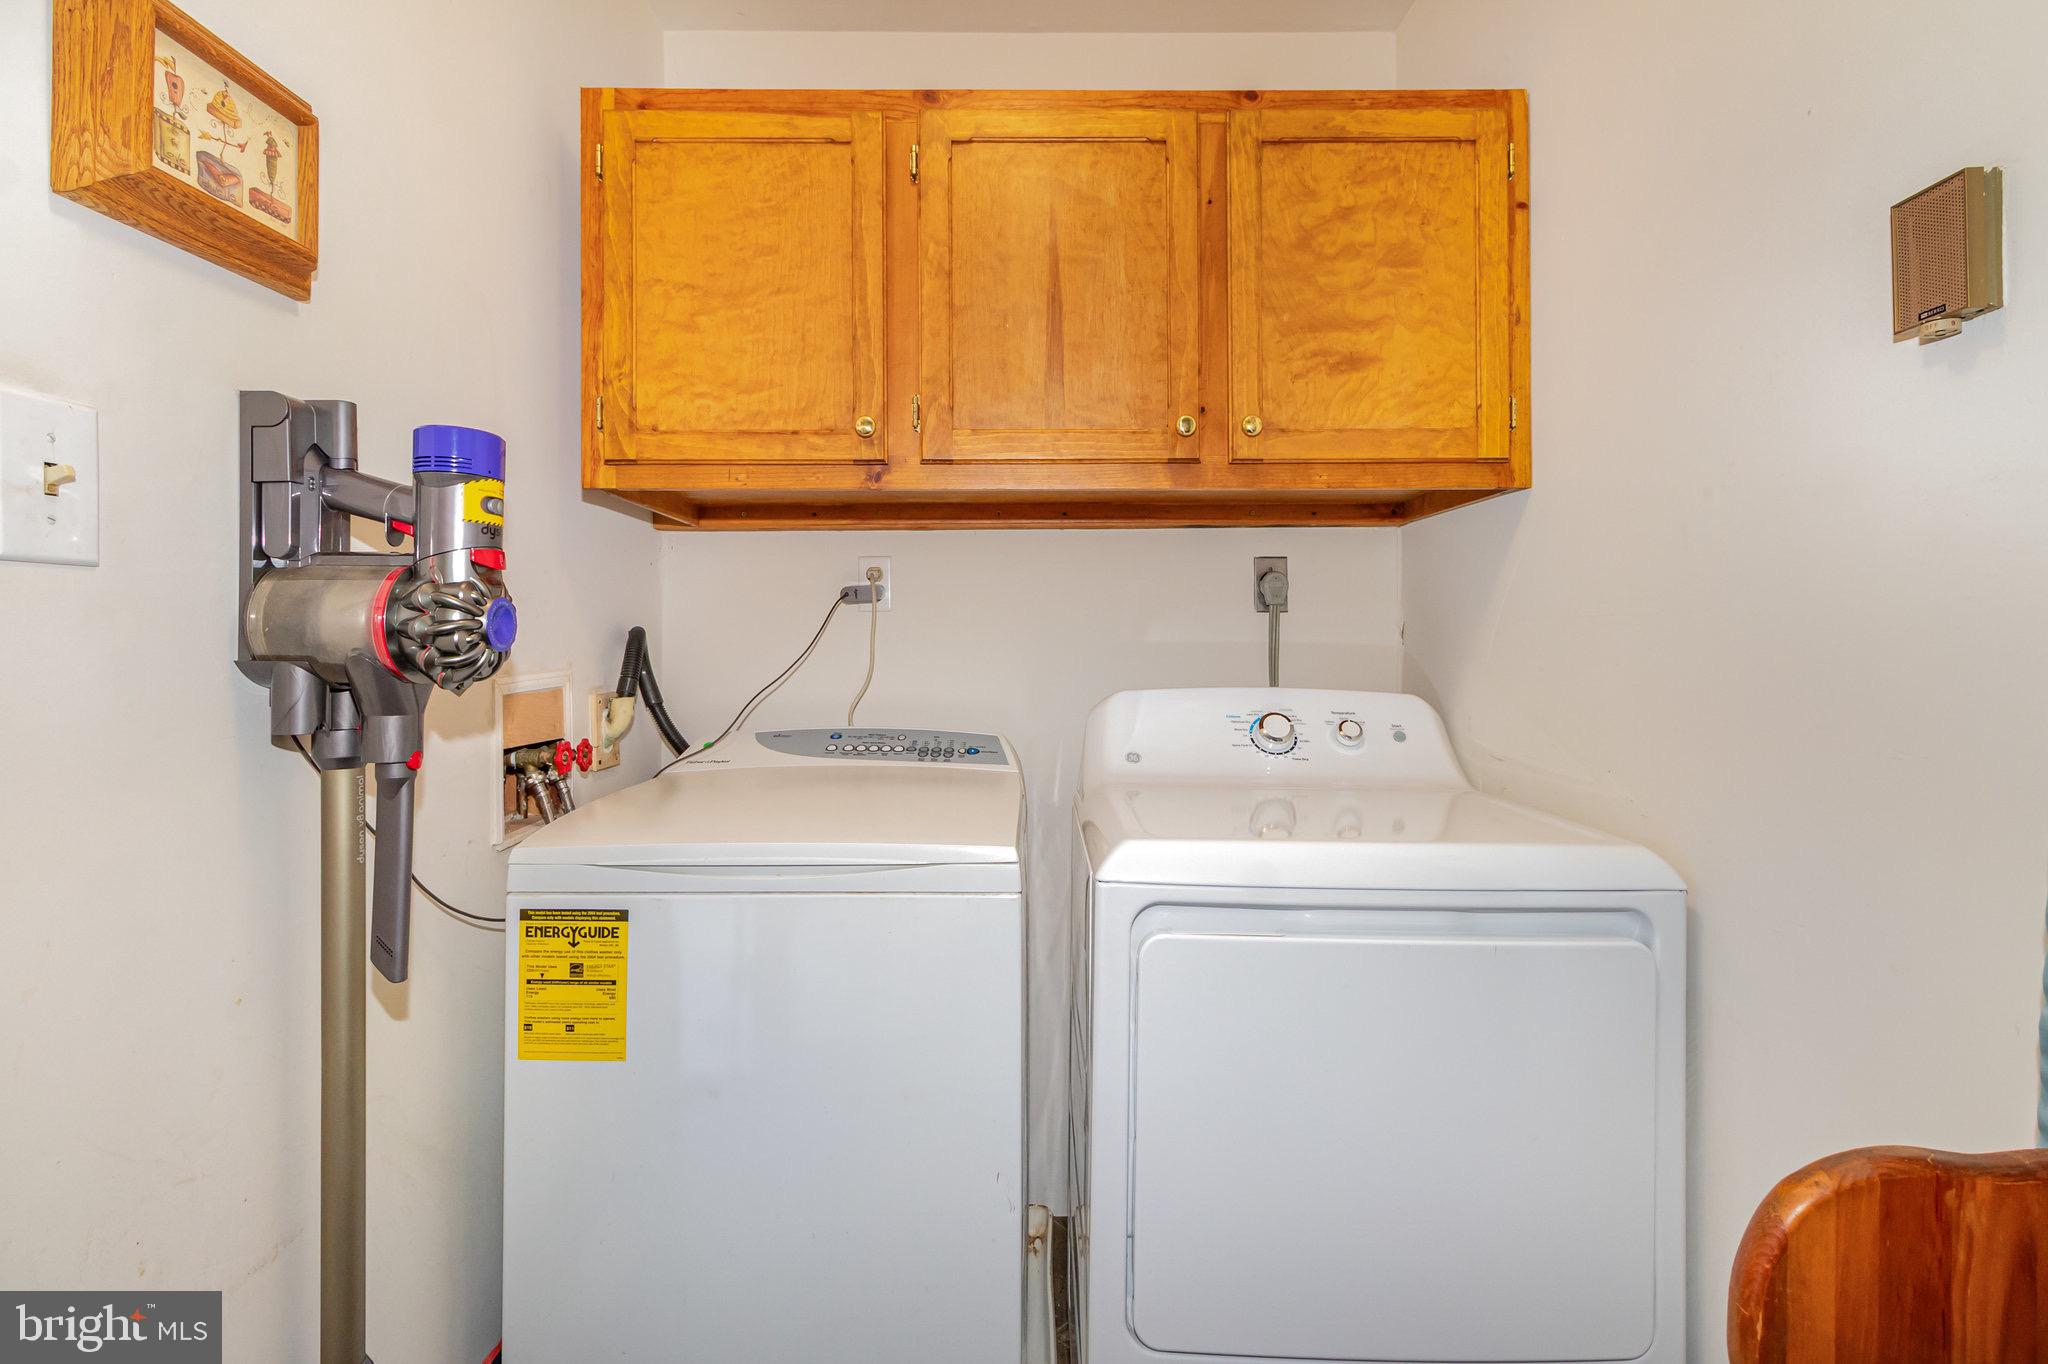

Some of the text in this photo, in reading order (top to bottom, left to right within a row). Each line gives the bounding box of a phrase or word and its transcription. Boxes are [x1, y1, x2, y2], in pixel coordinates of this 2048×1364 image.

[356, 775, 365, 813] animal
[356, 830, 365, 864] dyson
[525, 926, 620, 939] ENERGYGUIDE
